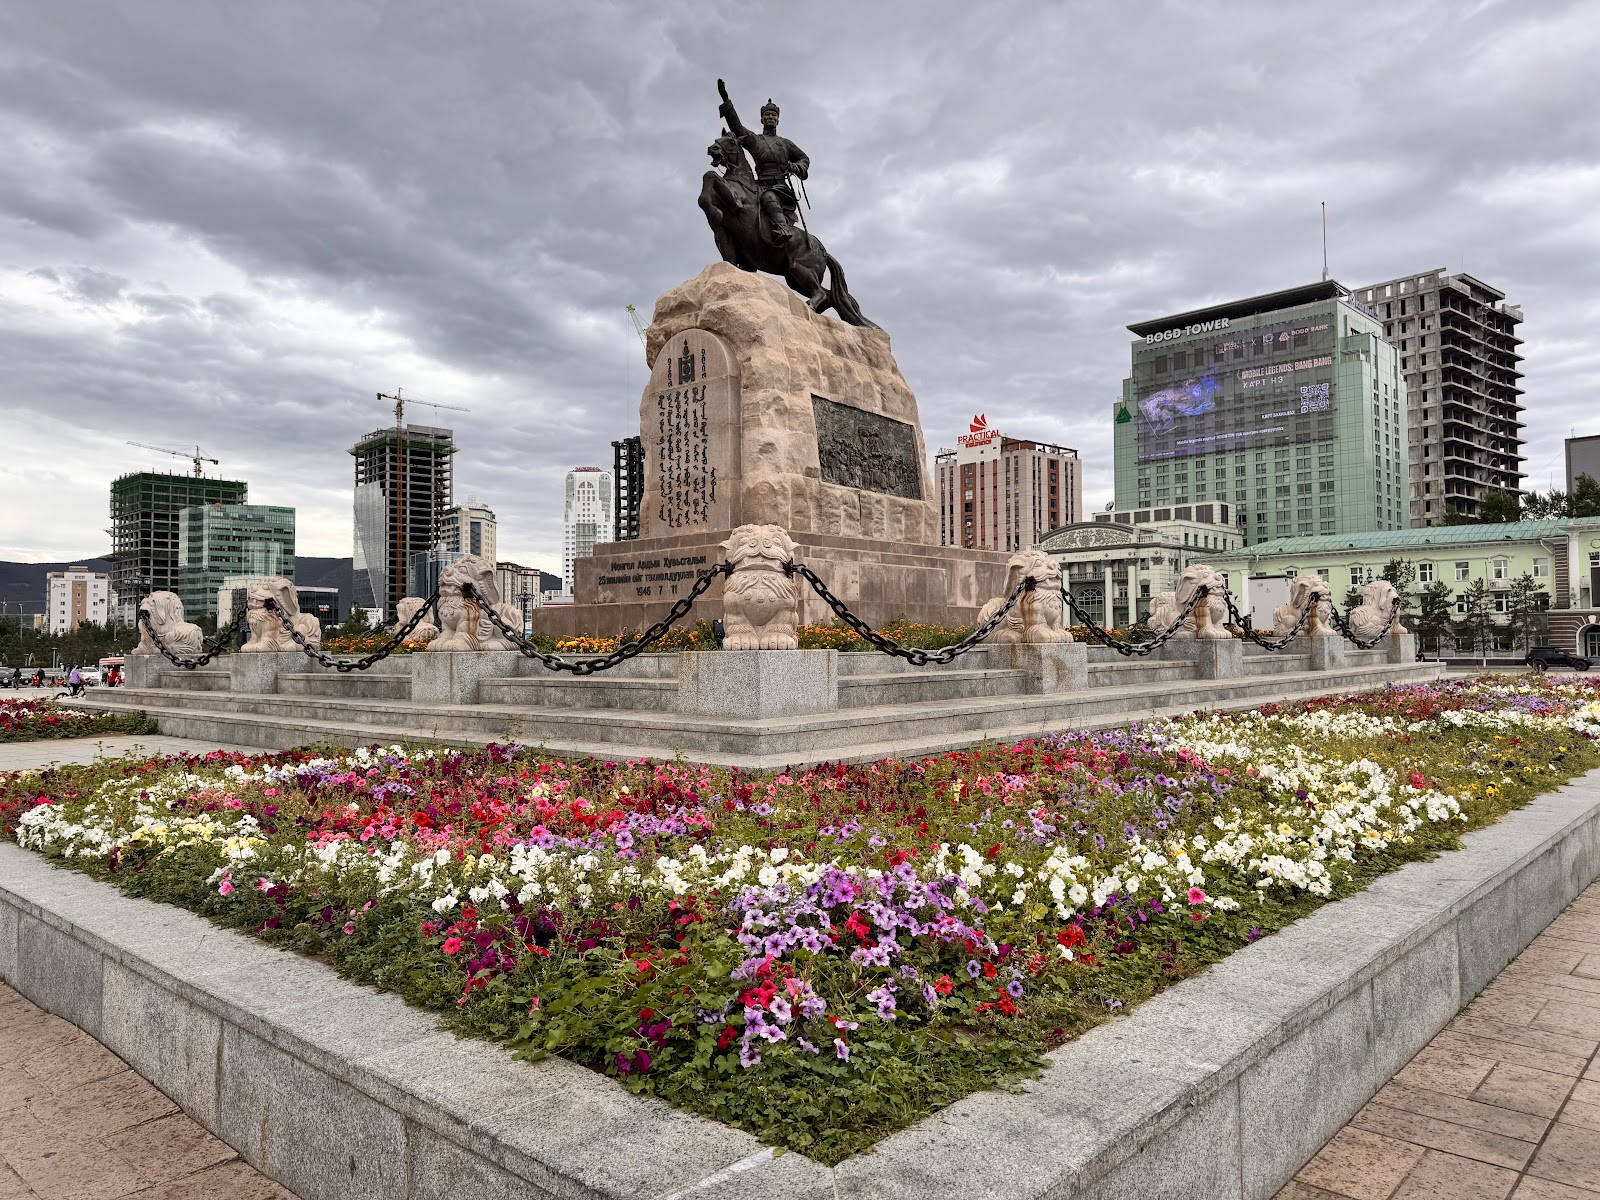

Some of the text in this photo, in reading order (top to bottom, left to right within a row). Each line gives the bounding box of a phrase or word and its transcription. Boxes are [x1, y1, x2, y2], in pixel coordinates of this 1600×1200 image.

[1146, 317, 1230, 344] BOGD TOWER
[1310, 323, 1328, 332] BANK
[1241, 356, 1332, 379] MOBILE LEGENDS: BANG BANG
[1243, 378, 1266, 389] КАРТ
[957, 429, 1001, 444] PRACTICAL
[610, 555, 707, 571] Монгол Ардын Хувьсгалын
[598, 575, 606, 586] 25
[636, 584, 678, 596] 1946 7 11
